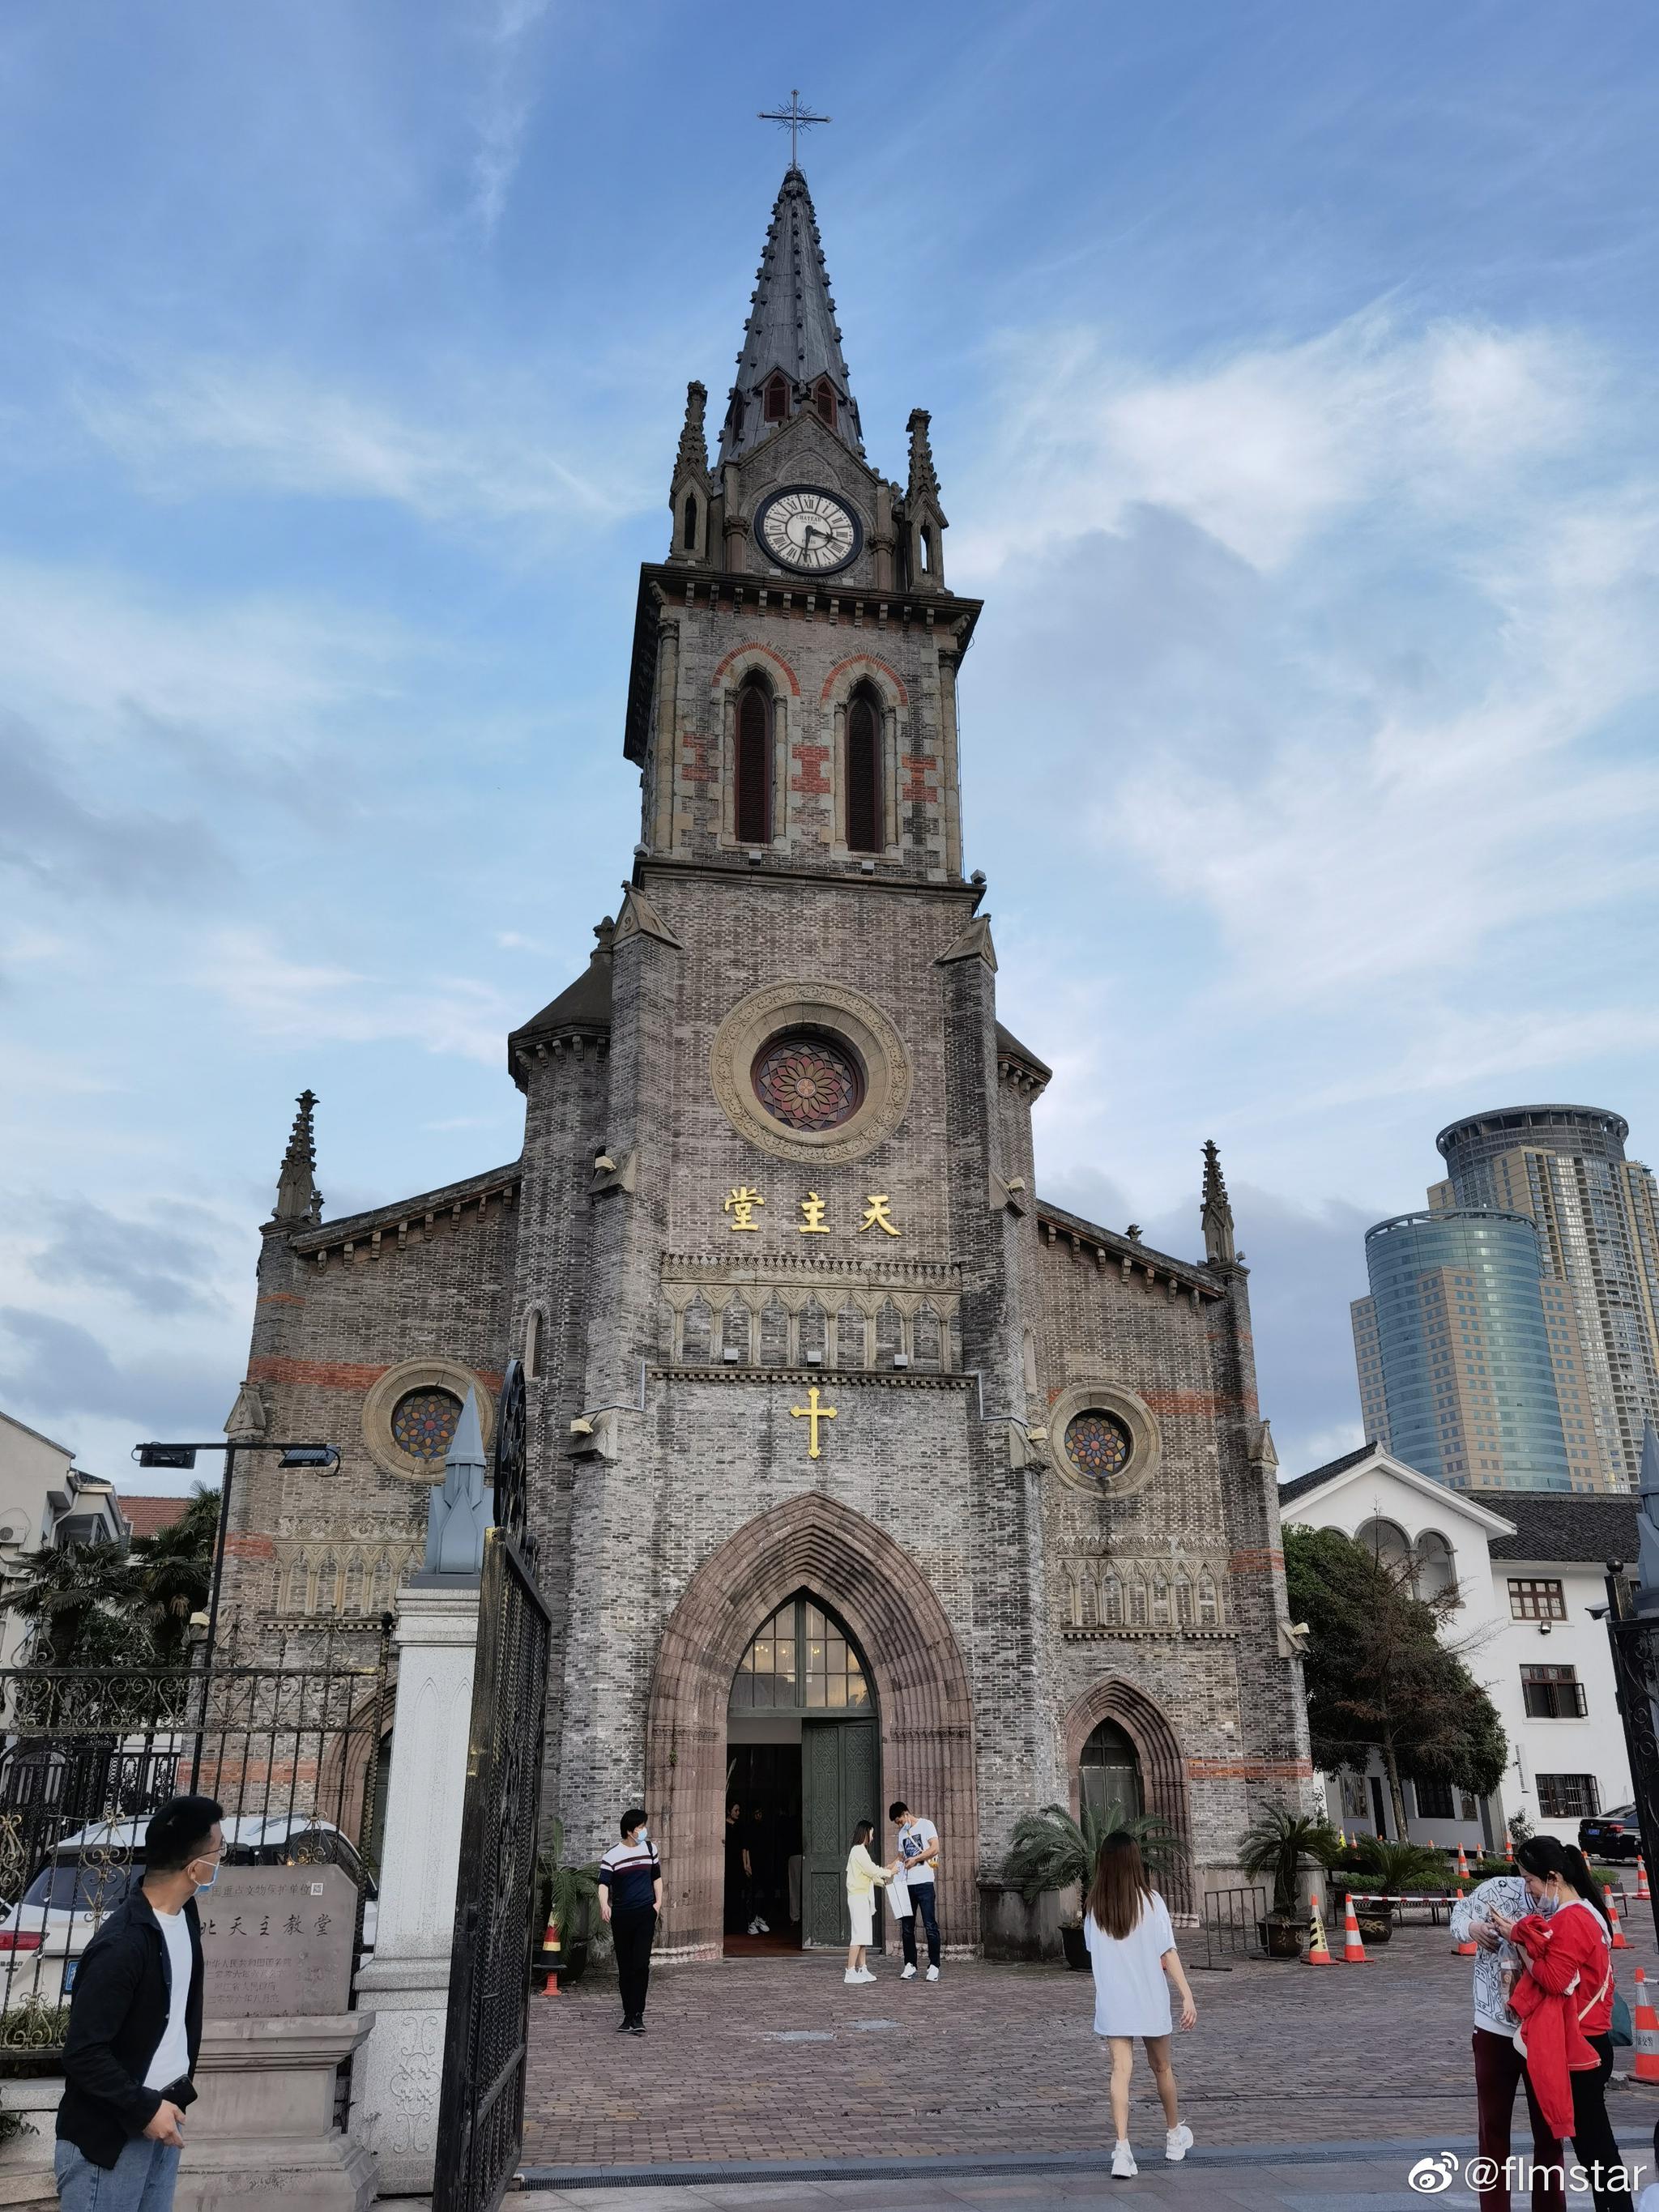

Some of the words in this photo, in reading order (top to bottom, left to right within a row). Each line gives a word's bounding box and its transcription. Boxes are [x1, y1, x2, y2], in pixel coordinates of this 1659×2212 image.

[804, 499, 814, 509] XII
[201, 1912, 332, 1937] 北天主教堂
